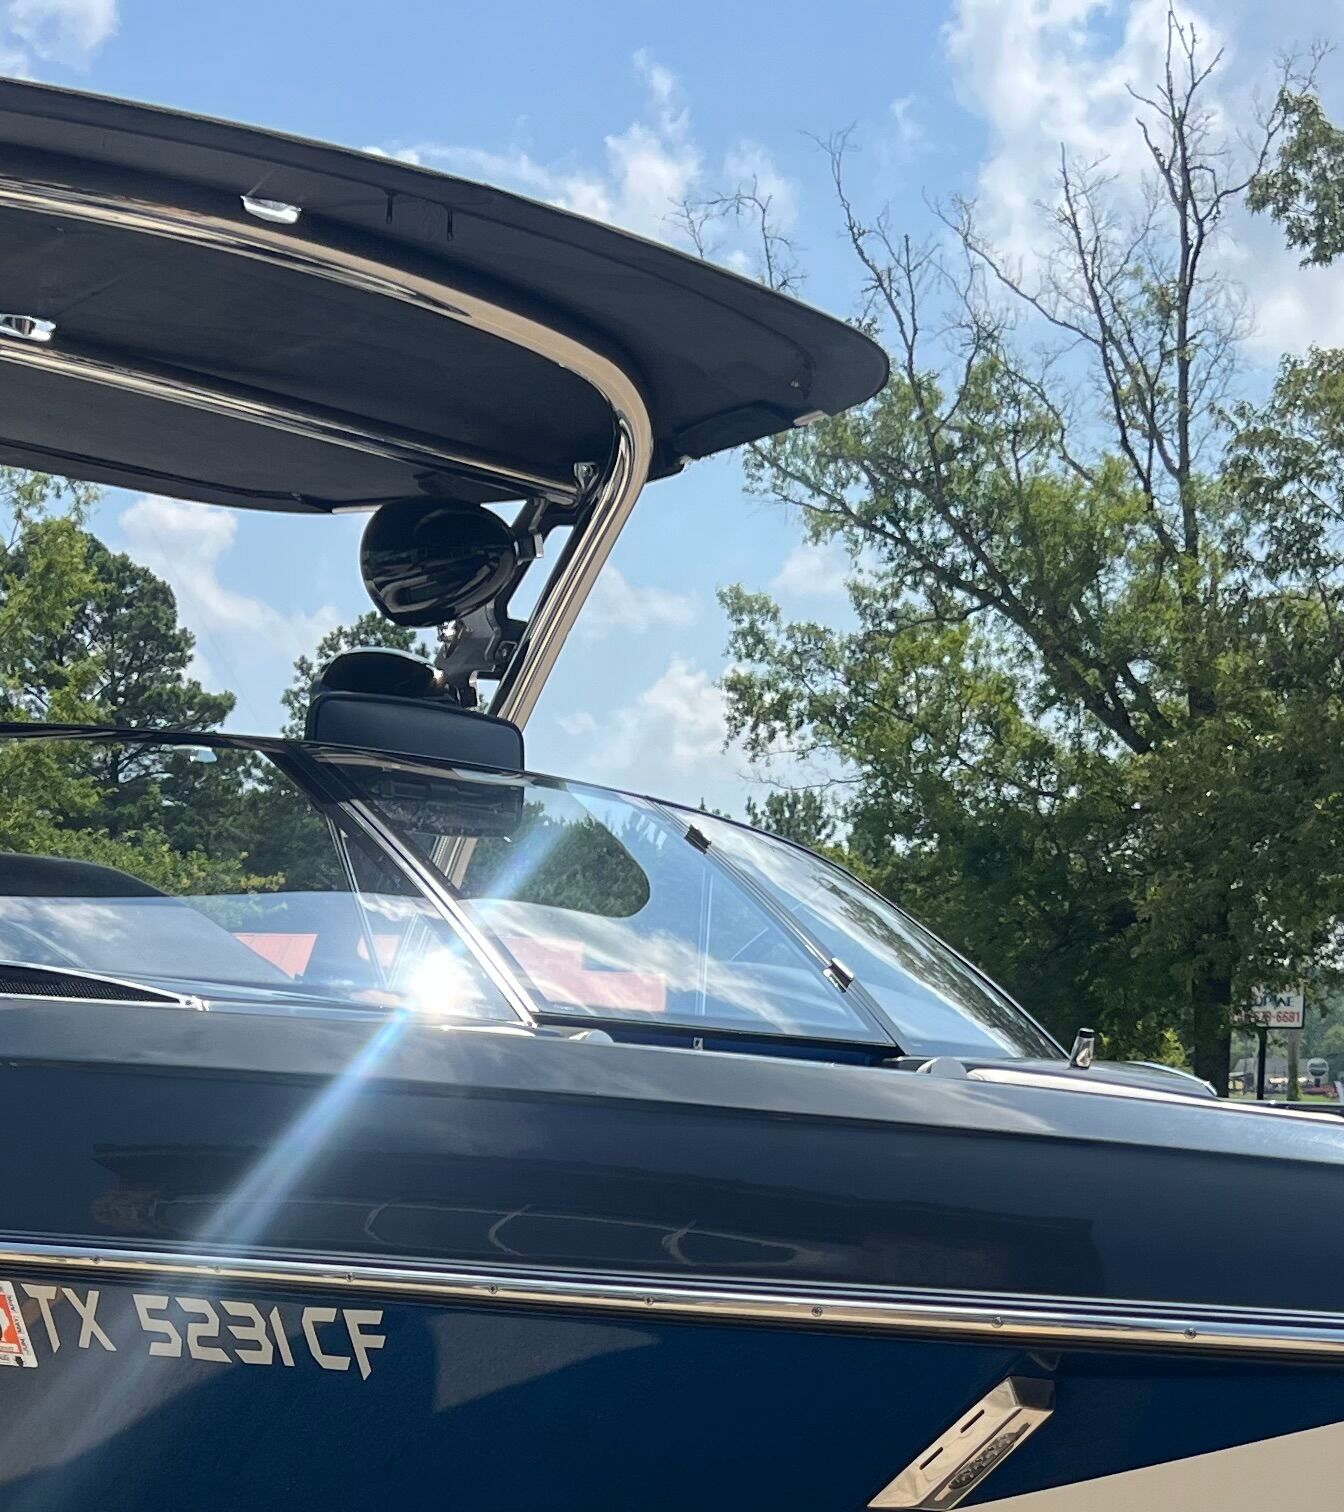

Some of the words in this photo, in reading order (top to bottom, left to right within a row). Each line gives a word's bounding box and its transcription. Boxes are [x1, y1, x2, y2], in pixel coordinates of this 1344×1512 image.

[21, 1284, 117, 1352] TX
[133, 1294, 295, 1366] 5231
[302, 1307, 386, 1380] CF
